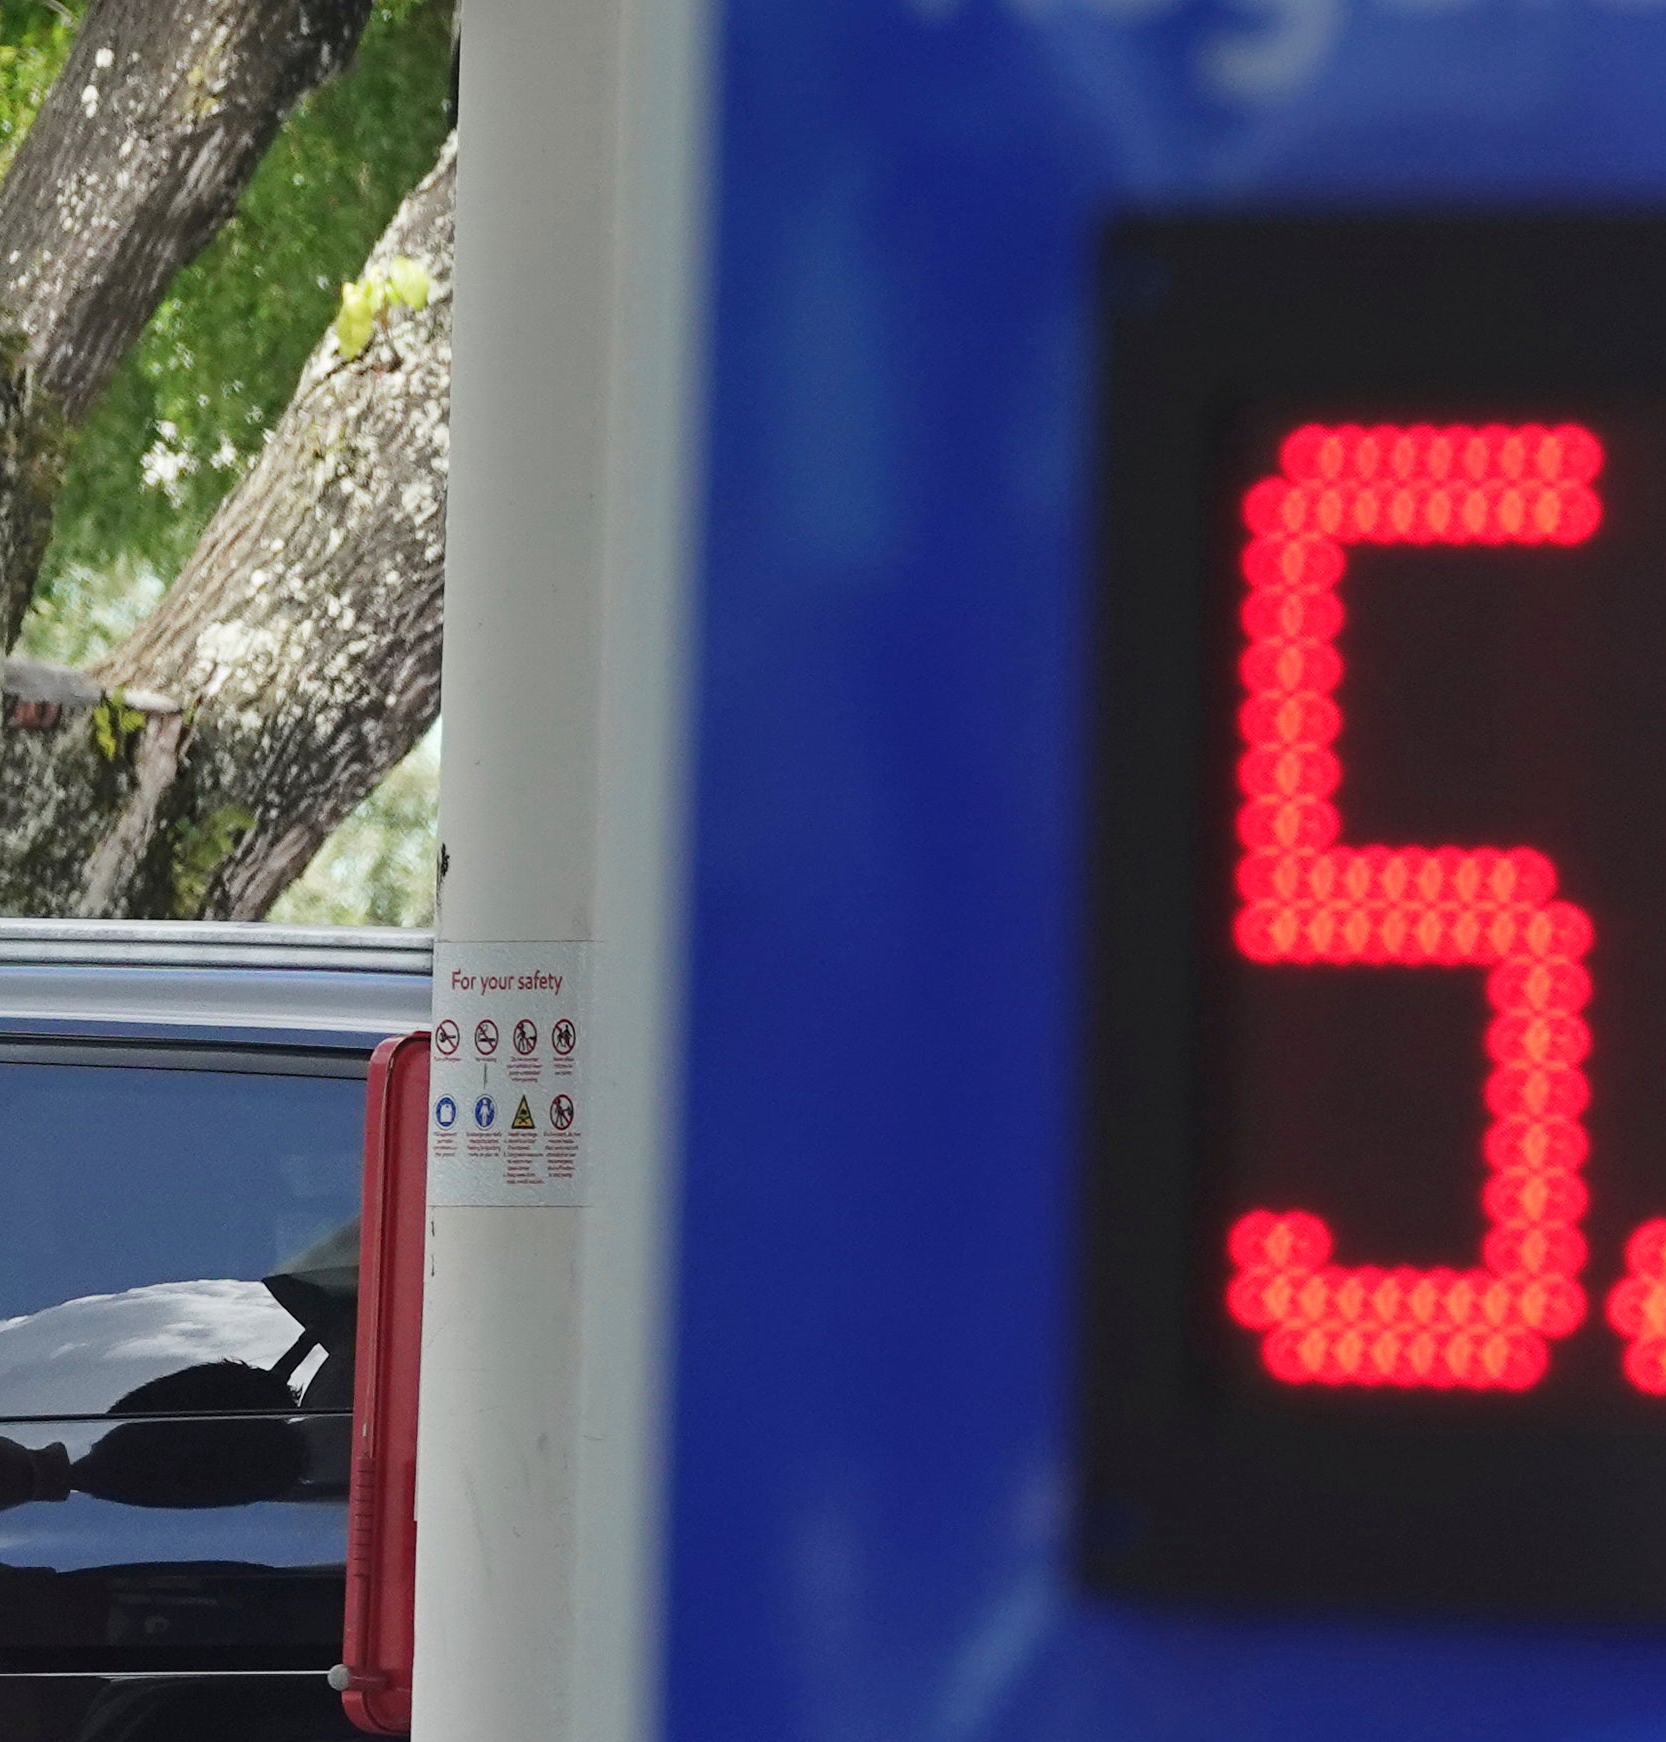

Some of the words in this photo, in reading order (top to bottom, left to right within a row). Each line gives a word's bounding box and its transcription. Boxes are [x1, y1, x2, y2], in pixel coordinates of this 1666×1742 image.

[451, 969, 477, 990] For
[480, 974, 514, 996] your
[517, 970, 563, 996] safety
